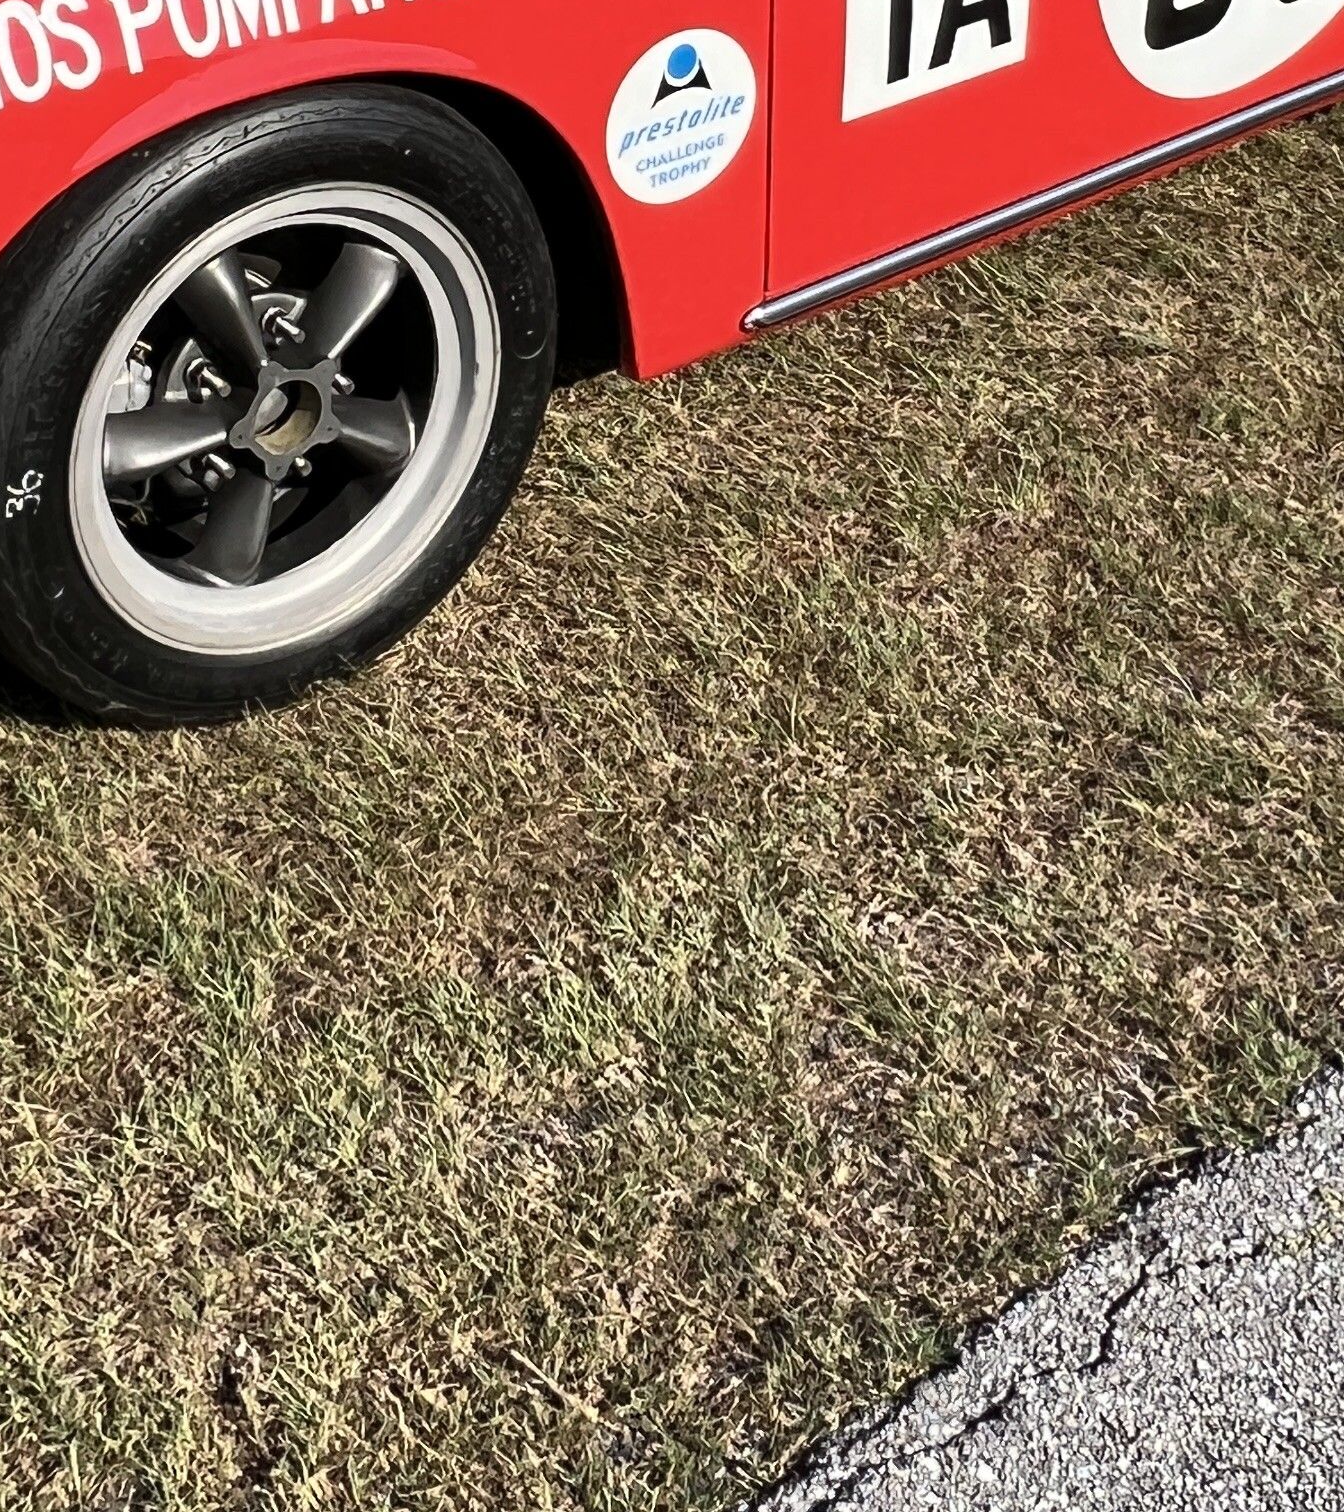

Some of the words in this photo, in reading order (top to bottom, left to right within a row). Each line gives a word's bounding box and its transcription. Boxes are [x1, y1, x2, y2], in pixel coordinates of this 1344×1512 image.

[618, 95, 746, 159] prestolite
[636, 133, 726, 173] CHALLENGE
[649, 156, 712, 188] TROPHY
